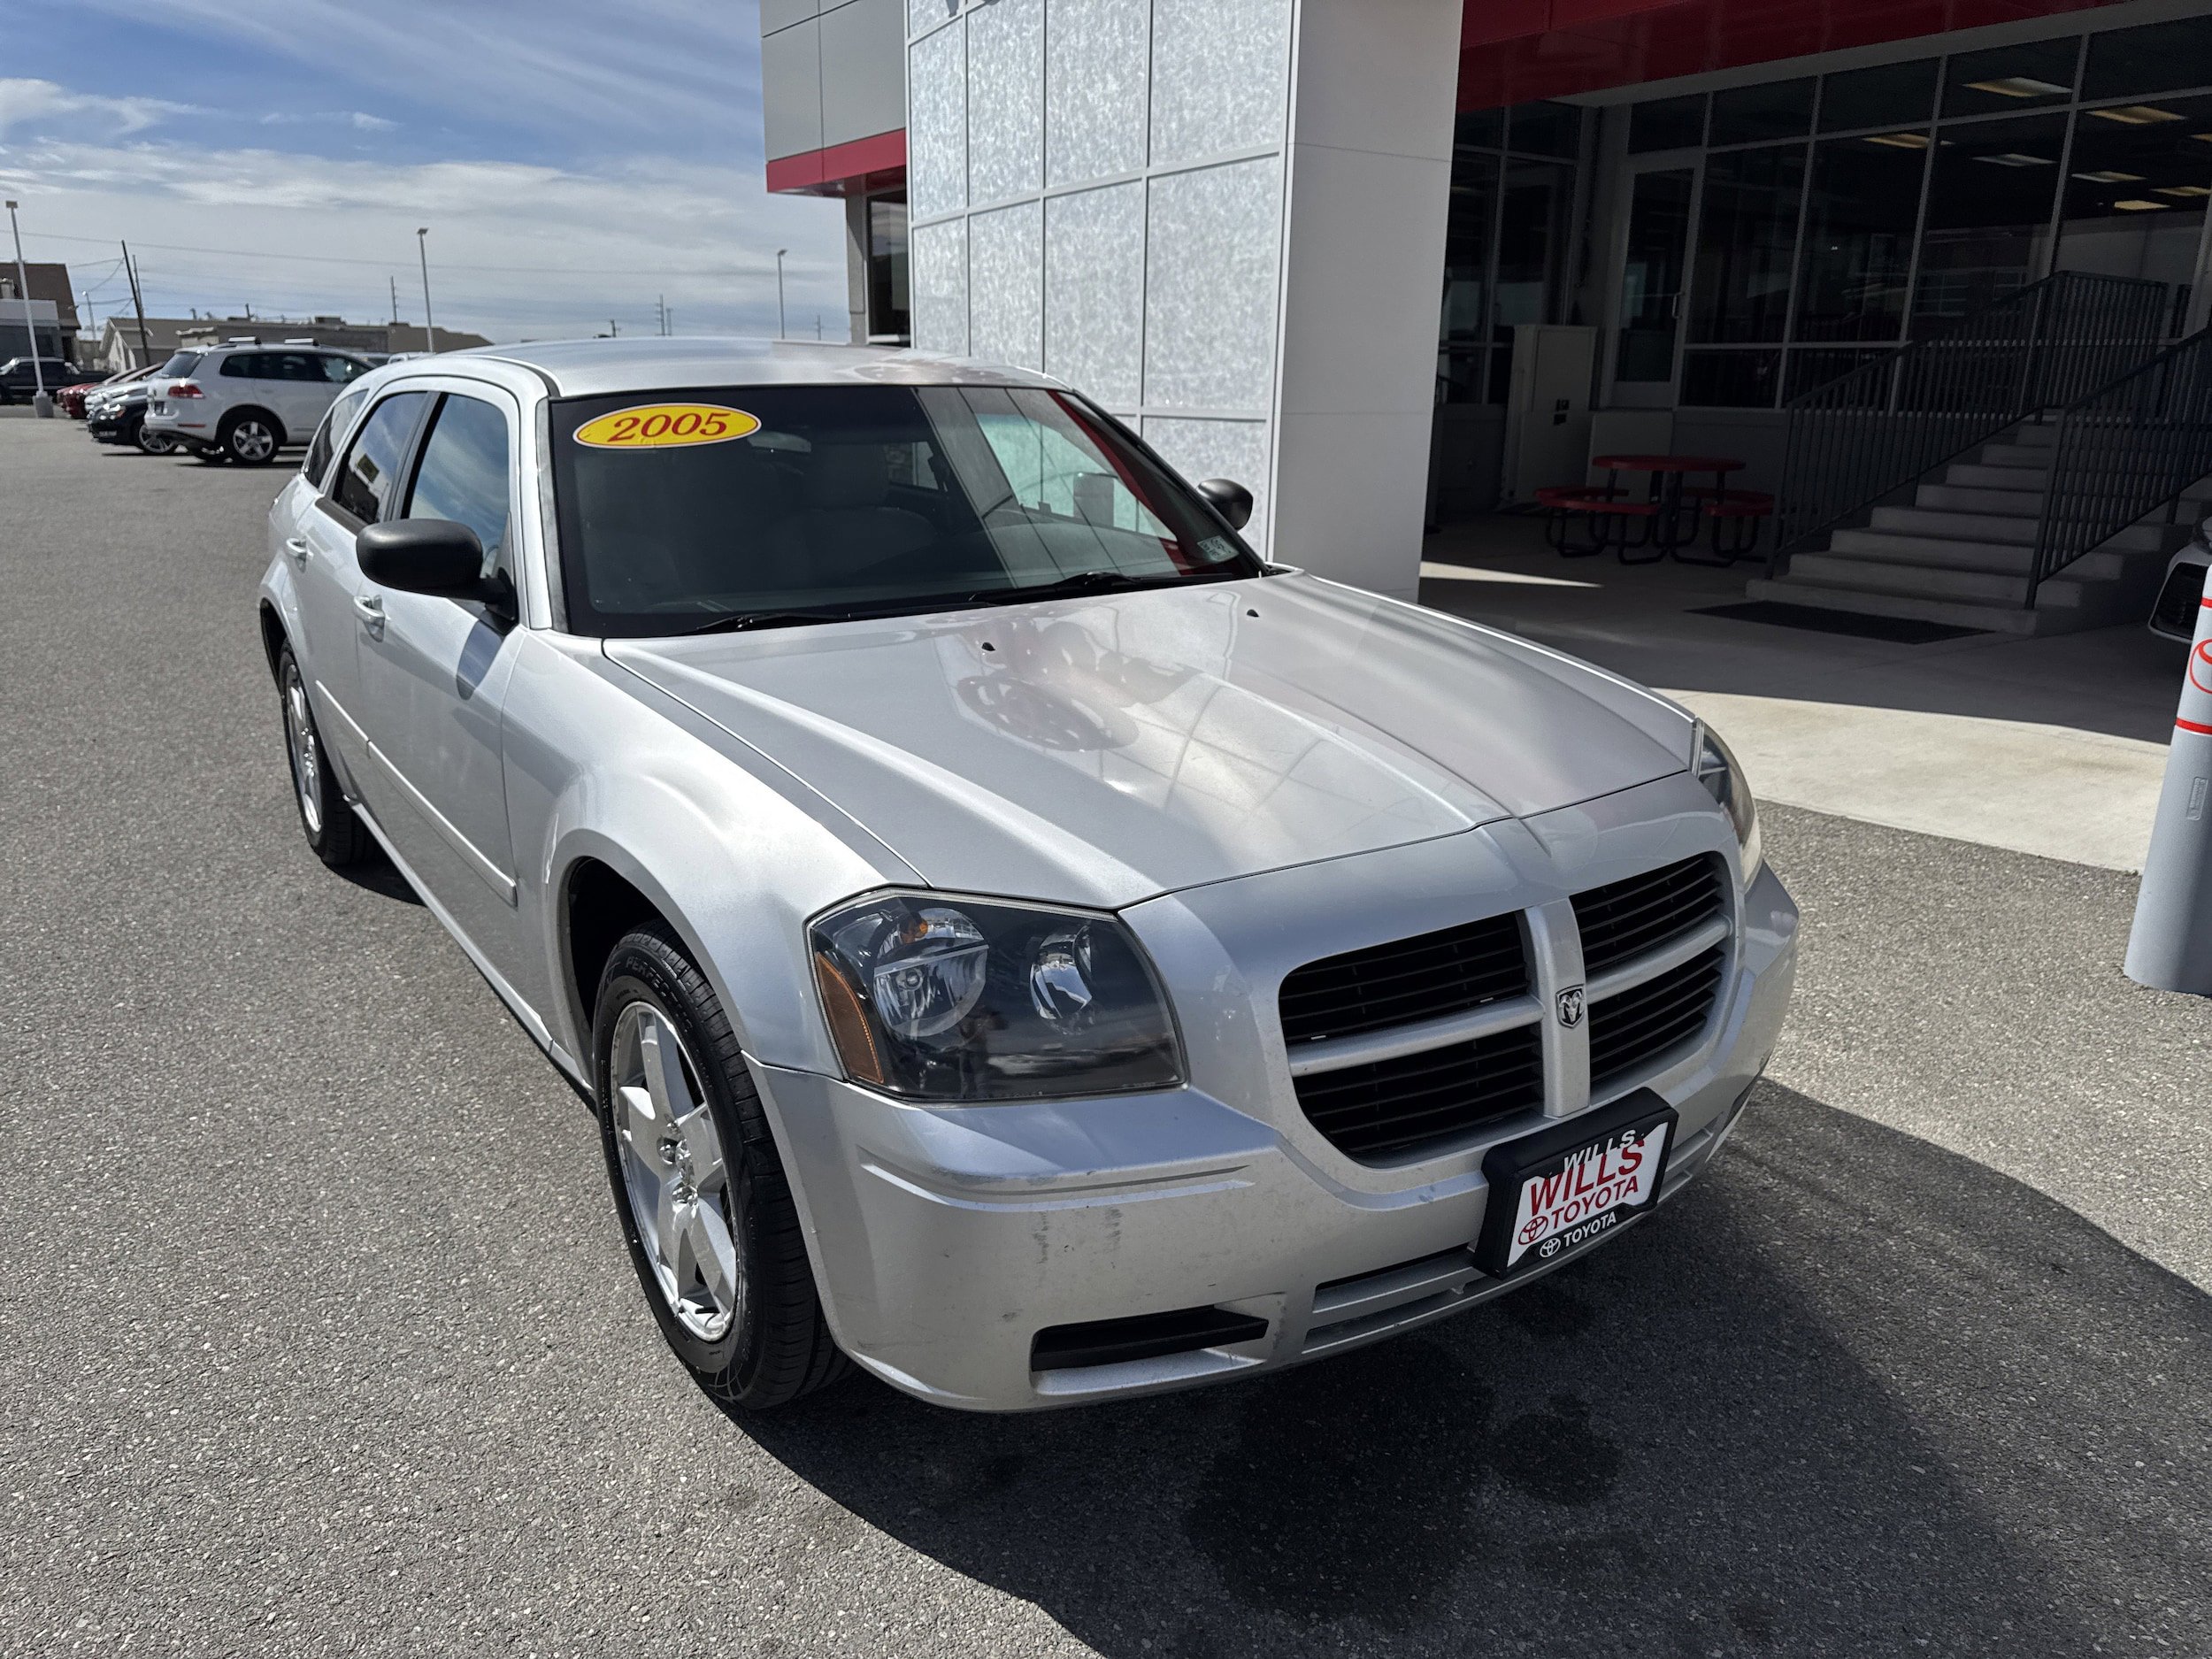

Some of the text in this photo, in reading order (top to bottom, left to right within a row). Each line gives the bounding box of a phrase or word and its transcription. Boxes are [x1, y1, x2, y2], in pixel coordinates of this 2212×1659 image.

[607, 412, 731, 442] 2005
[1563, 1129, 1636, 1170] WILLS
[1531, 1139, 1645, 1217] WILLS
[1551, 1175, 1639, 1229] TOYOTA
[1563, 1210, 1617, 1248] TOYOTA
